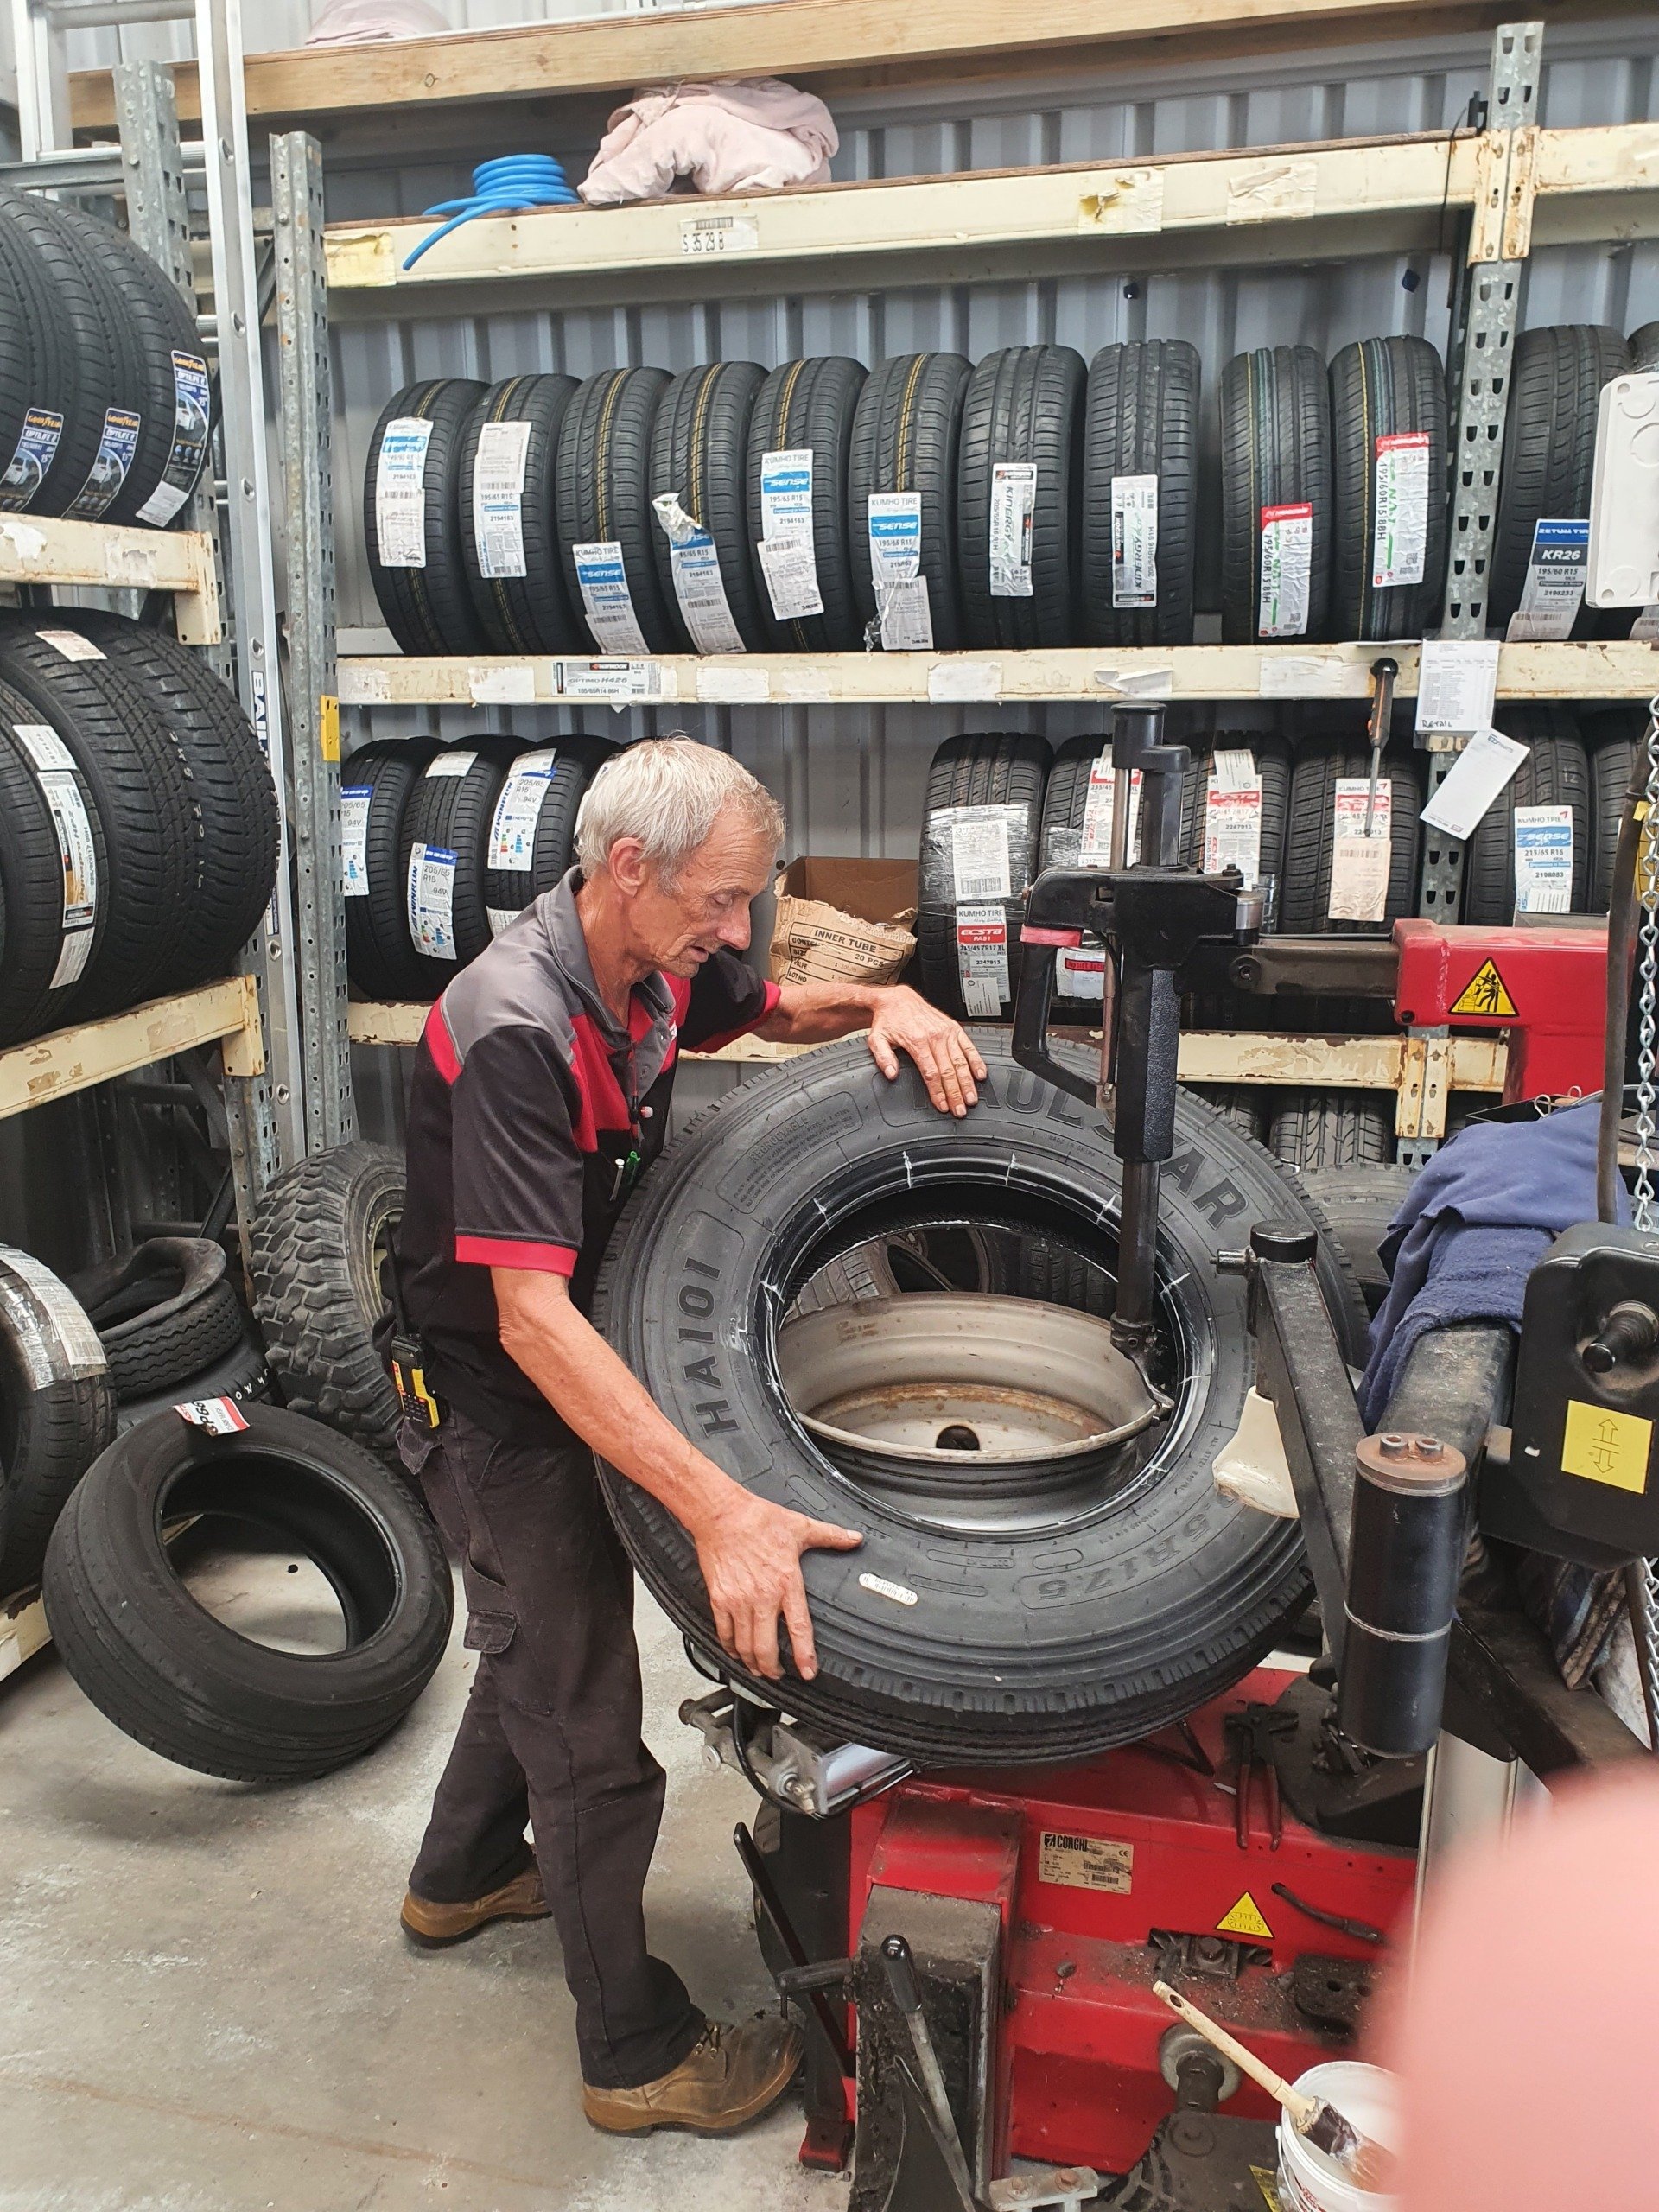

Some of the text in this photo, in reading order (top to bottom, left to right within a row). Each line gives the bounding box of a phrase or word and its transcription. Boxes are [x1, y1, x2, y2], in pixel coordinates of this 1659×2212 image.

[792, 454, 809, 462] TIRE
[871, 498, 899, 506] KUMHO
[1541, 549, 1581, 561] KR26
[958, 909, 987, 918] KUMHO
[814, 928, 877, 954] INNER TUBE
[854, 953, 885, 968] 20 PCS
[1057, 1834, 1088, 1852] CORGHI
